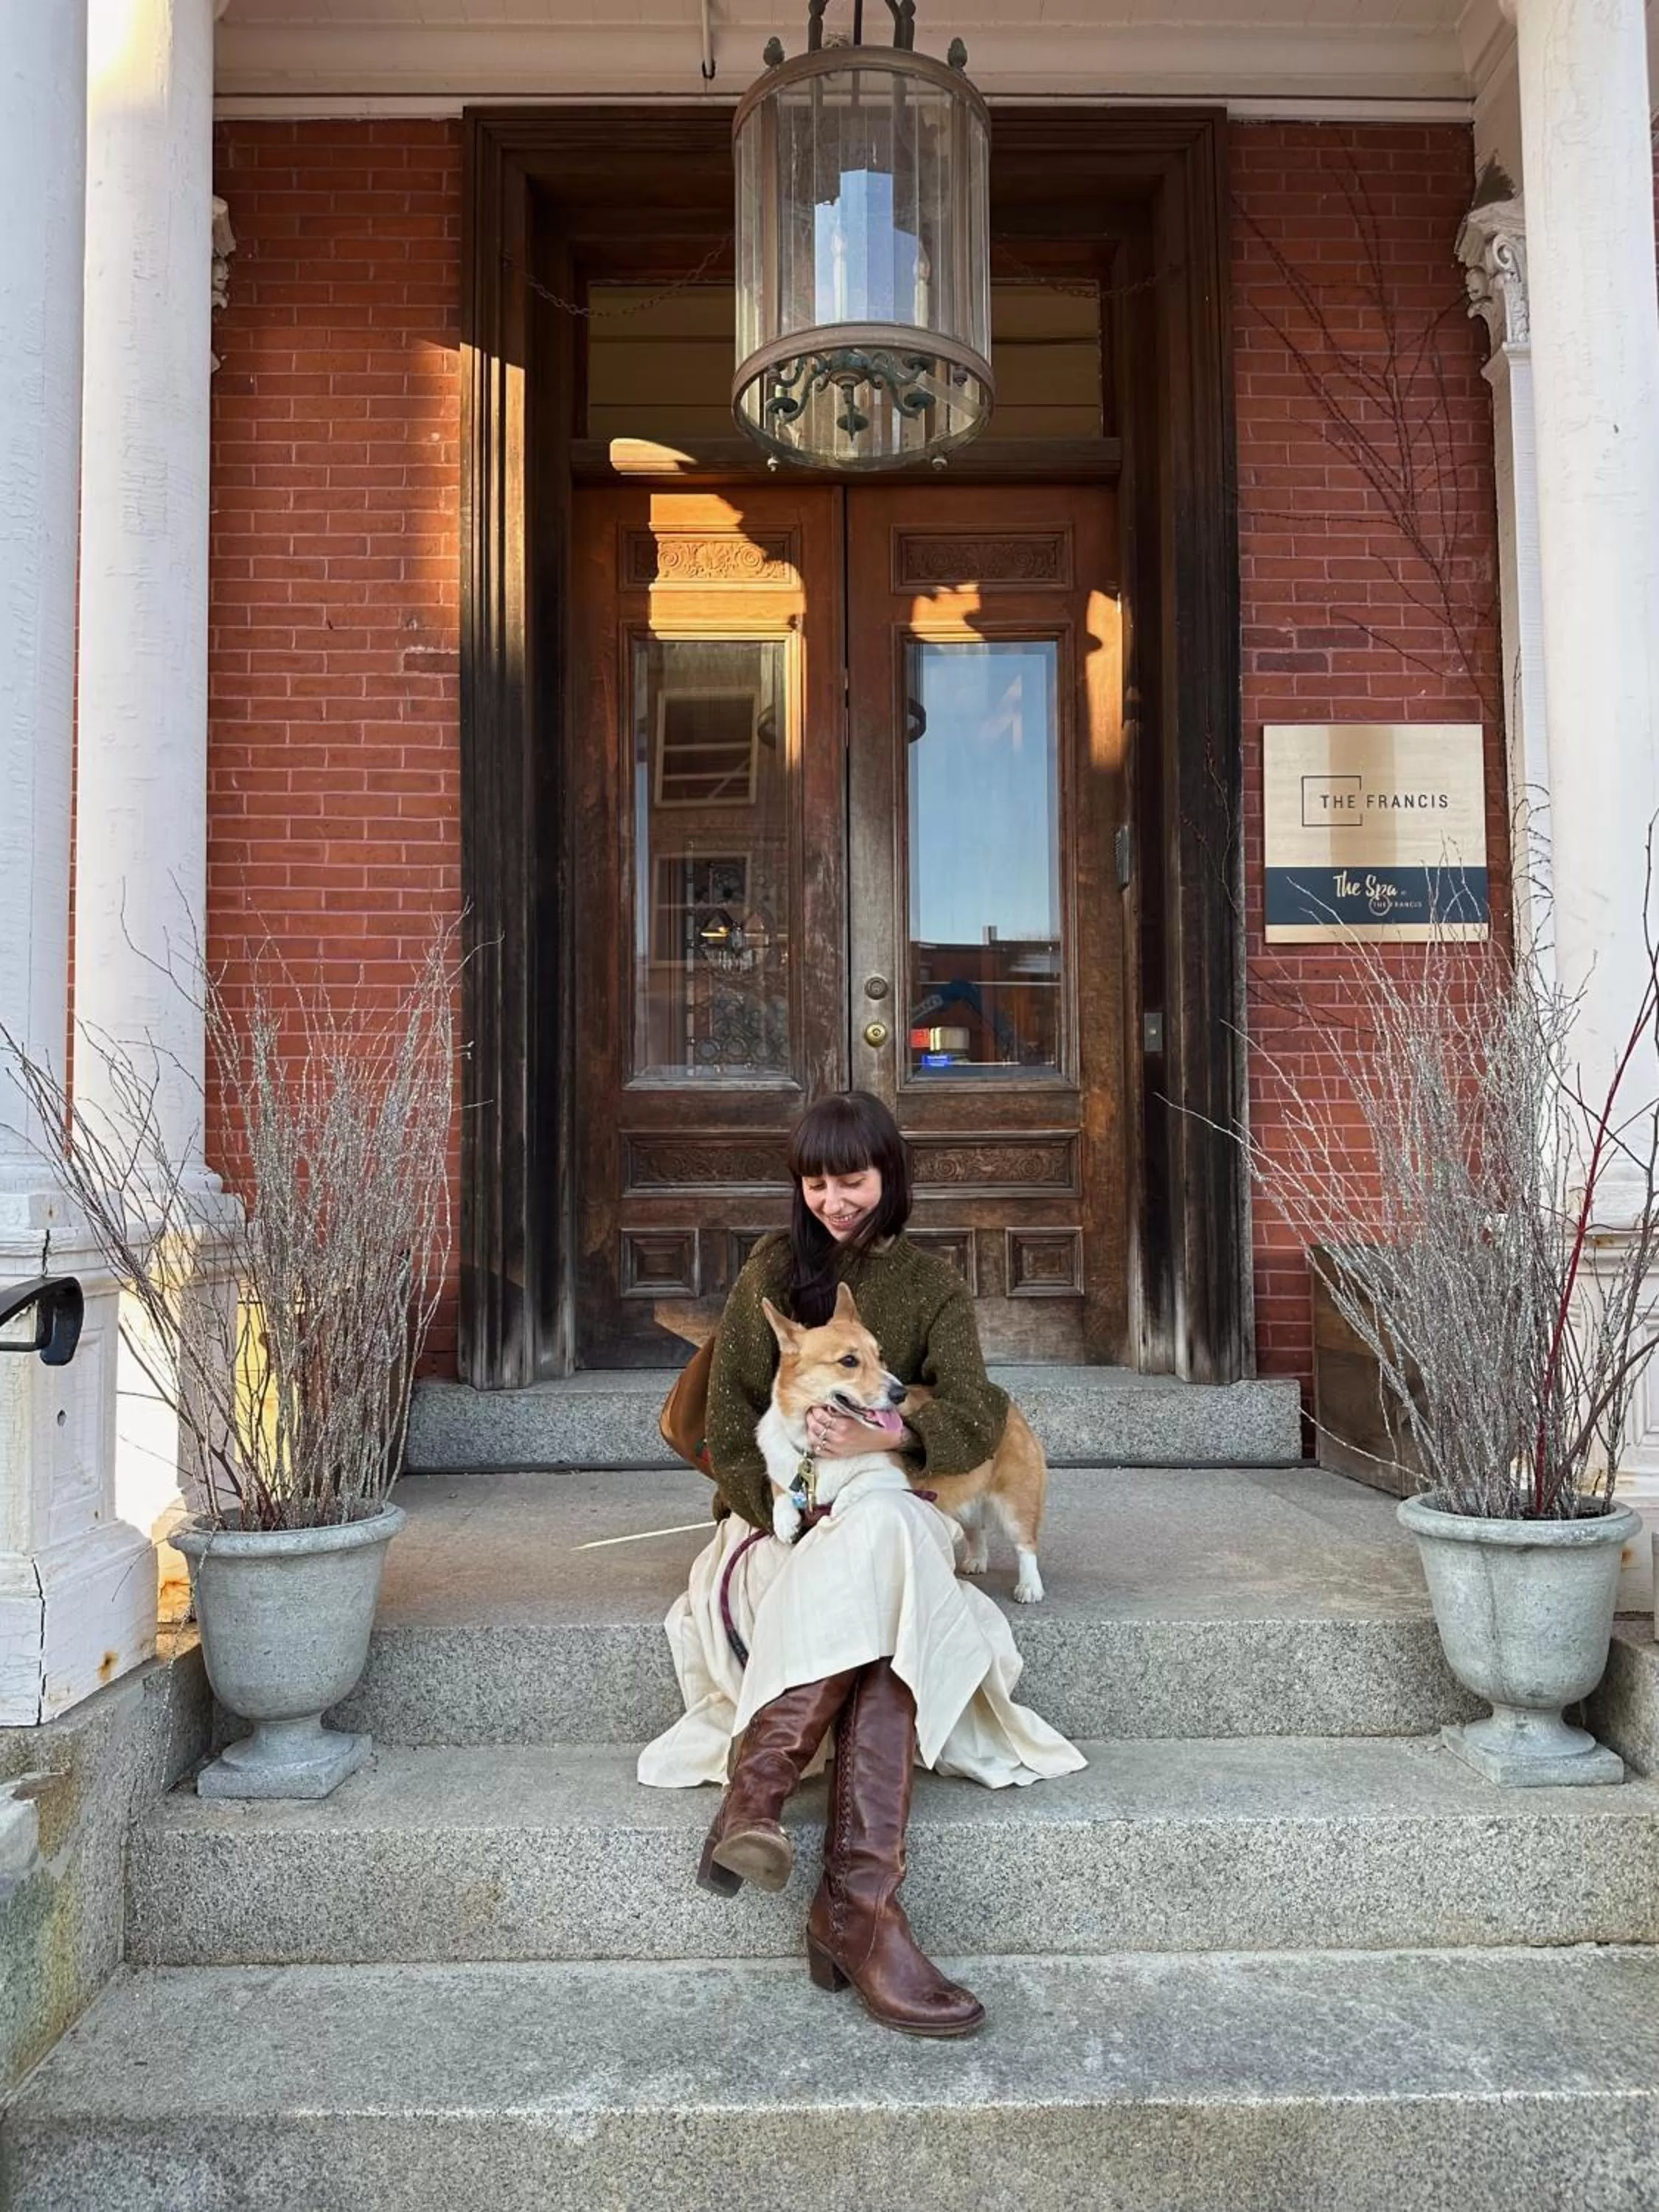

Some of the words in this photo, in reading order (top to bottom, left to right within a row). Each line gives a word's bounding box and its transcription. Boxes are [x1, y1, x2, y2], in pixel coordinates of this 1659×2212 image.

[1320, 794, 1356, 809] THE
[1366, 794, 1449, 809] FRANCIS
[1332, 869, 1361, 897] The
[1365, 874, 1398, 900] Spa
